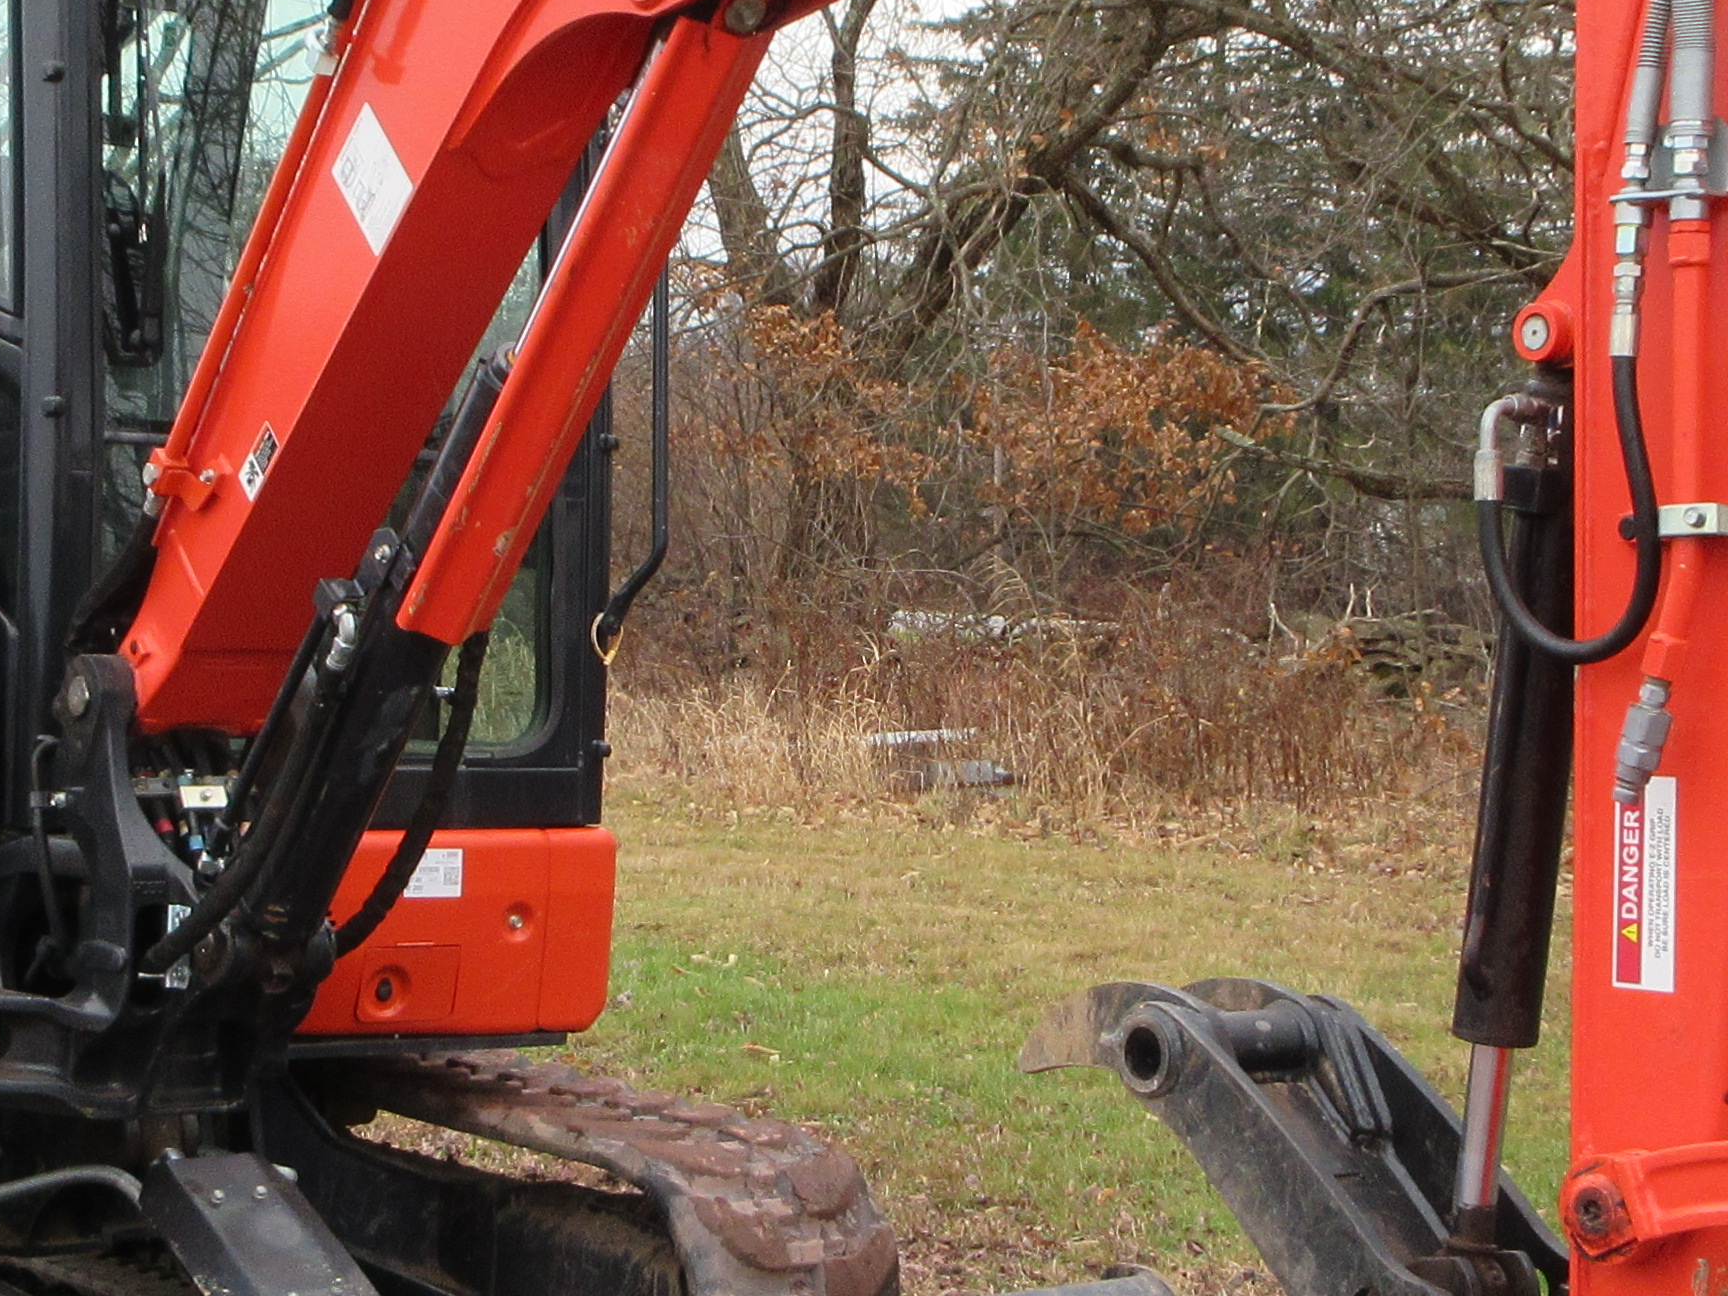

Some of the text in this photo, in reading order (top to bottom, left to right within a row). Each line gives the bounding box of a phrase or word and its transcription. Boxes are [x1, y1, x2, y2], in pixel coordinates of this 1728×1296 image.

[1622, 810, 1641, 920] DANGER
[1654, 944, 1661, 959] DO
[1661, 939, 1668, 952] BE
